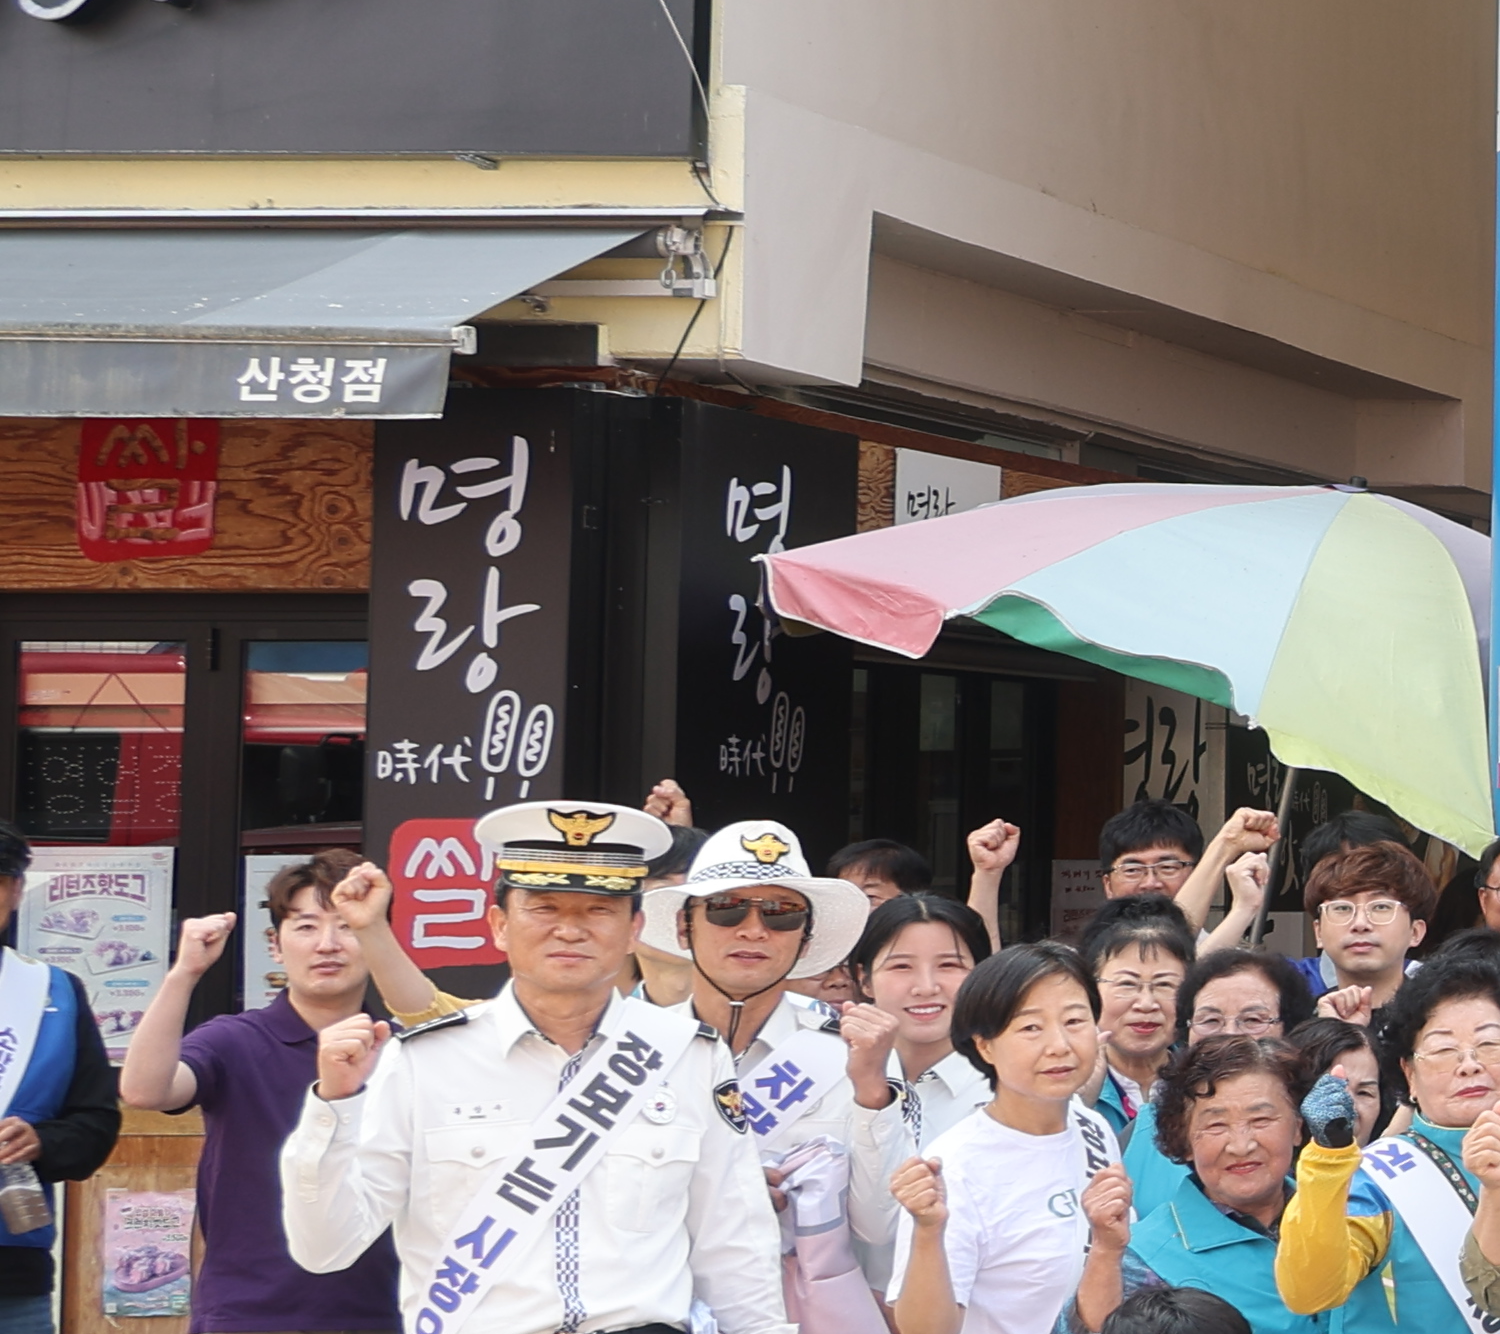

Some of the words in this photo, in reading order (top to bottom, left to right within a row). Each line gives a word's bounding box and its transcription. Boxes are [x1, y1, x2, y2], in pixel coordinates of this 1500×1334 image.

[236, 357, 388, 405] 산청점
[401, 435, 541, 694] 명랑
[377, 737, 473, 785] 時代
[495, 1030, 664, 1215] 장보기는
[738, 1060, 816, 1137] 차량
